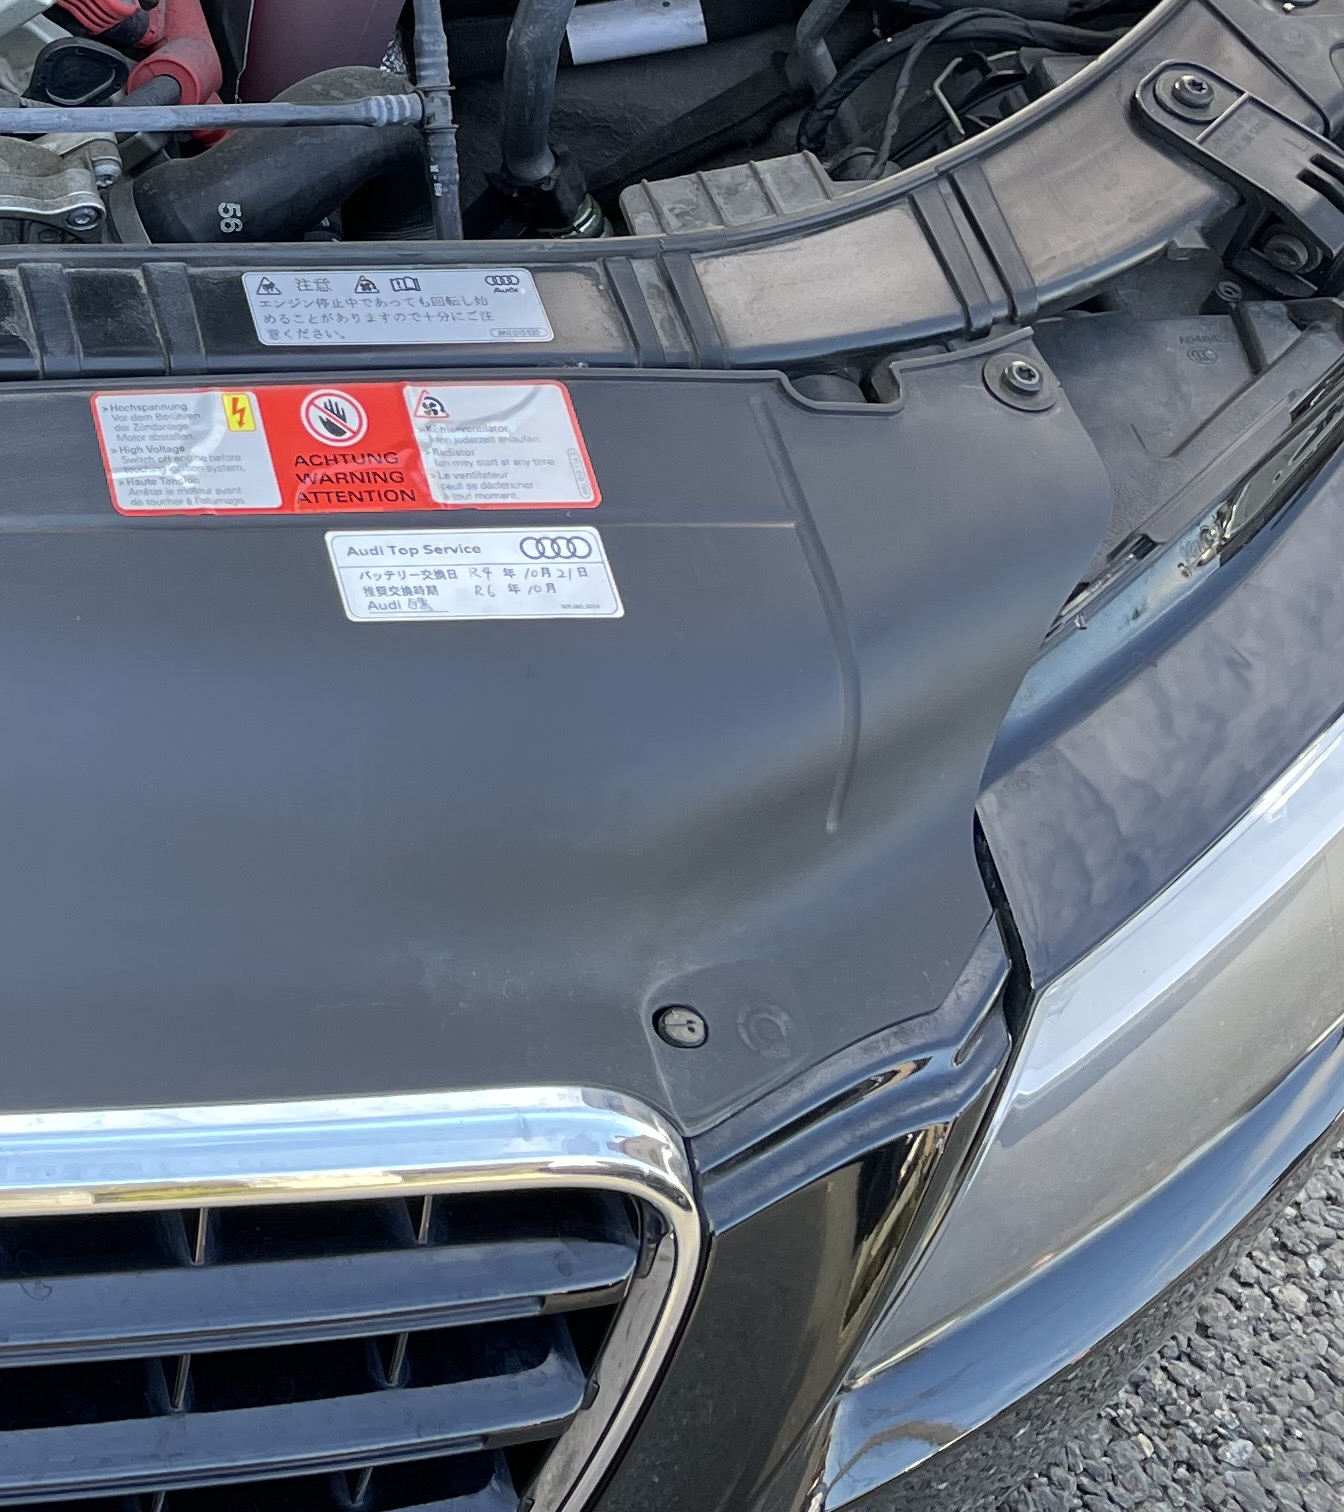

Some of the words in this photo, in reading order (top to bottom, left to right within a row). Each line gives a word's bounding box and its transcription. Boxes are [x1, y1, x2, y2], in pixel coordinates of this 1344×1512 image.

[217, 202, 243, 233] 56
[295, 277, 332, 292] 注意
[259, 295, 489, 308] エンジン停止中であっても回転し始
[263, 311, 495, 324] めることがありますので十分にご注
[268, 328, 346, 341] 意ください。
[110, 403, 188, 413] Hochspannung
[112, 414, 128, 422] Vor
[131, 413, 153, 421] dem
[114, 424, 130, 432] der
[116, 433, 146, 442] Motor
[119, 445, 144, 455] High
[147, 445, 186, 455] Voltage
[432, 448, 475, 457] Radiator
[121, 455, 156, 464] Switch
[209, 454, 242, 462] before
[294, 451, 399, 466] ACHTUNG
[452, 459, 473, 468] may
[476, 458, 498, 466] start
[513, 459, 530, 468] any
[532, 457, 555, 466] time
[296, 471, 405, 484] WARNING
[438, 471, 450, 480] Le
[453, 471, 509, 480] ventilateur
[127, 478, 157, 486] Haute
[131, 498, 143, 506] de
[297, 489, 416, 504] ATTENTION
[347, 545, 385, 557] Audi
[389, 545, 419, 558] Top
[423, 543, 482, 555] Service
[359, 568, 459, 582] バッテリー交換日
[367, 599, 402, 611] Audi
